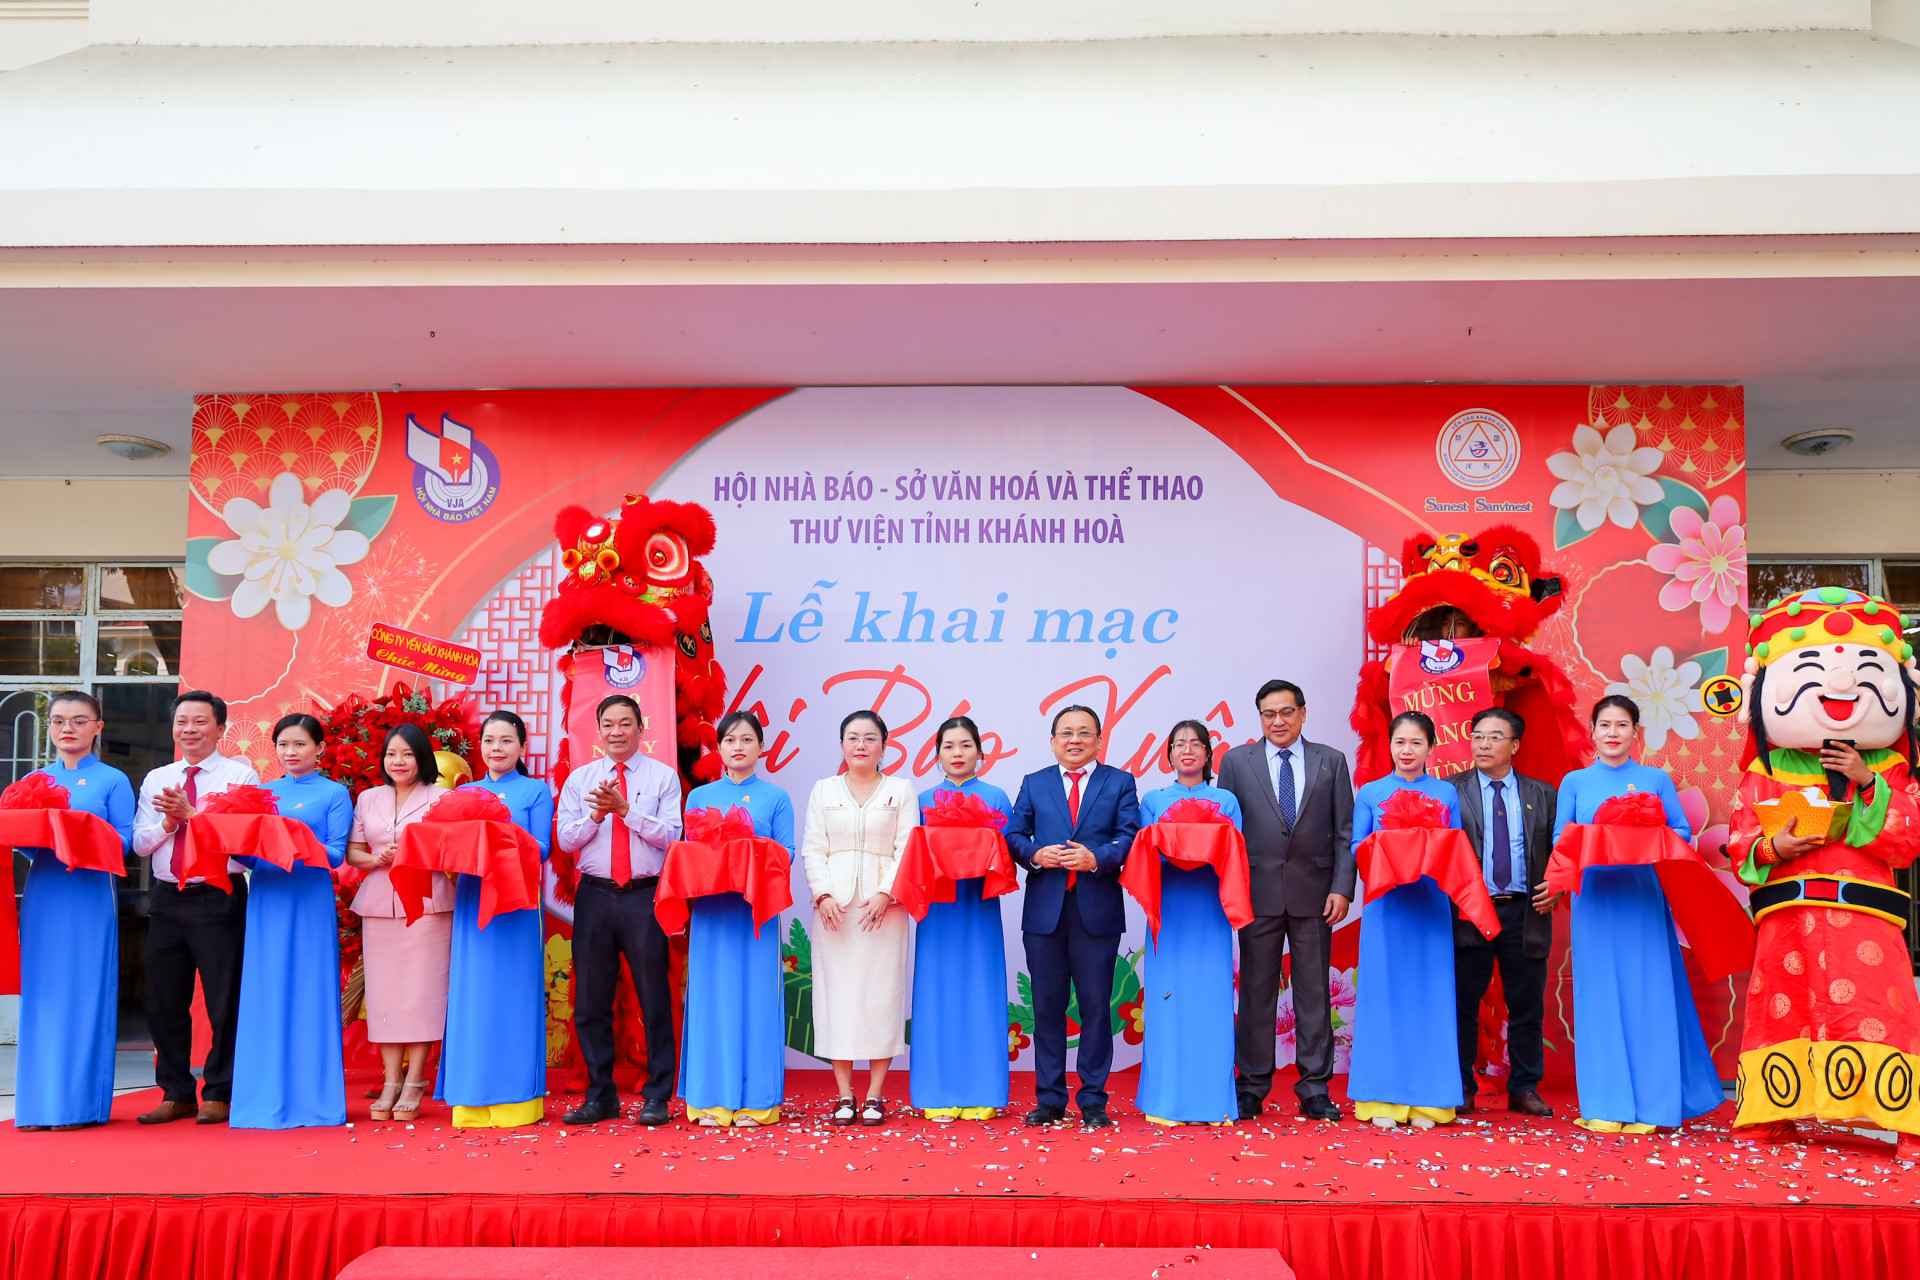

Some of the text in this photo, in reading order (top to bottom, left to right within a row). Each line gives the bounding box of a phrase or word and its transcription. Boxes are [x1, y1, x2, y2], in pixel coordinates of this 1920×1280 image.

[416, 486, 497, 521] HỘI NHÀ BÁO VIỆT NAM
[447, 498, 464, 508] VJA
[714, 471, 756, 508] HỘI
[764, 471, 816, 501] NHÀ
[824, 471, 873, 501] BÁO
[895, 468, 927, 501] SỞ
[932, 470, 981, 501] VĂN
[990, 470, 1040, 501] HOÁ
[1046, 470, 1078, 501] VÀ
[1084, 466, 1133, 501] THỂ
[1137, 475, 1204, 501] THAO
[1425, 497, 1533, 512] Sanest Sanvinest
[790, 510, 1125, 551] THƯ VIỆN TỈNH KHÁNH HOÀ
[735, 579, 1179, 659] Lễ khai mạc
[370, 628, 479, 668] CÔNG TY YẾN SÀO KHÁNH HÒA
[376, 648, 467, 682] Chúc Mừng
[1402, 681, 1475, 712] MỪNG
